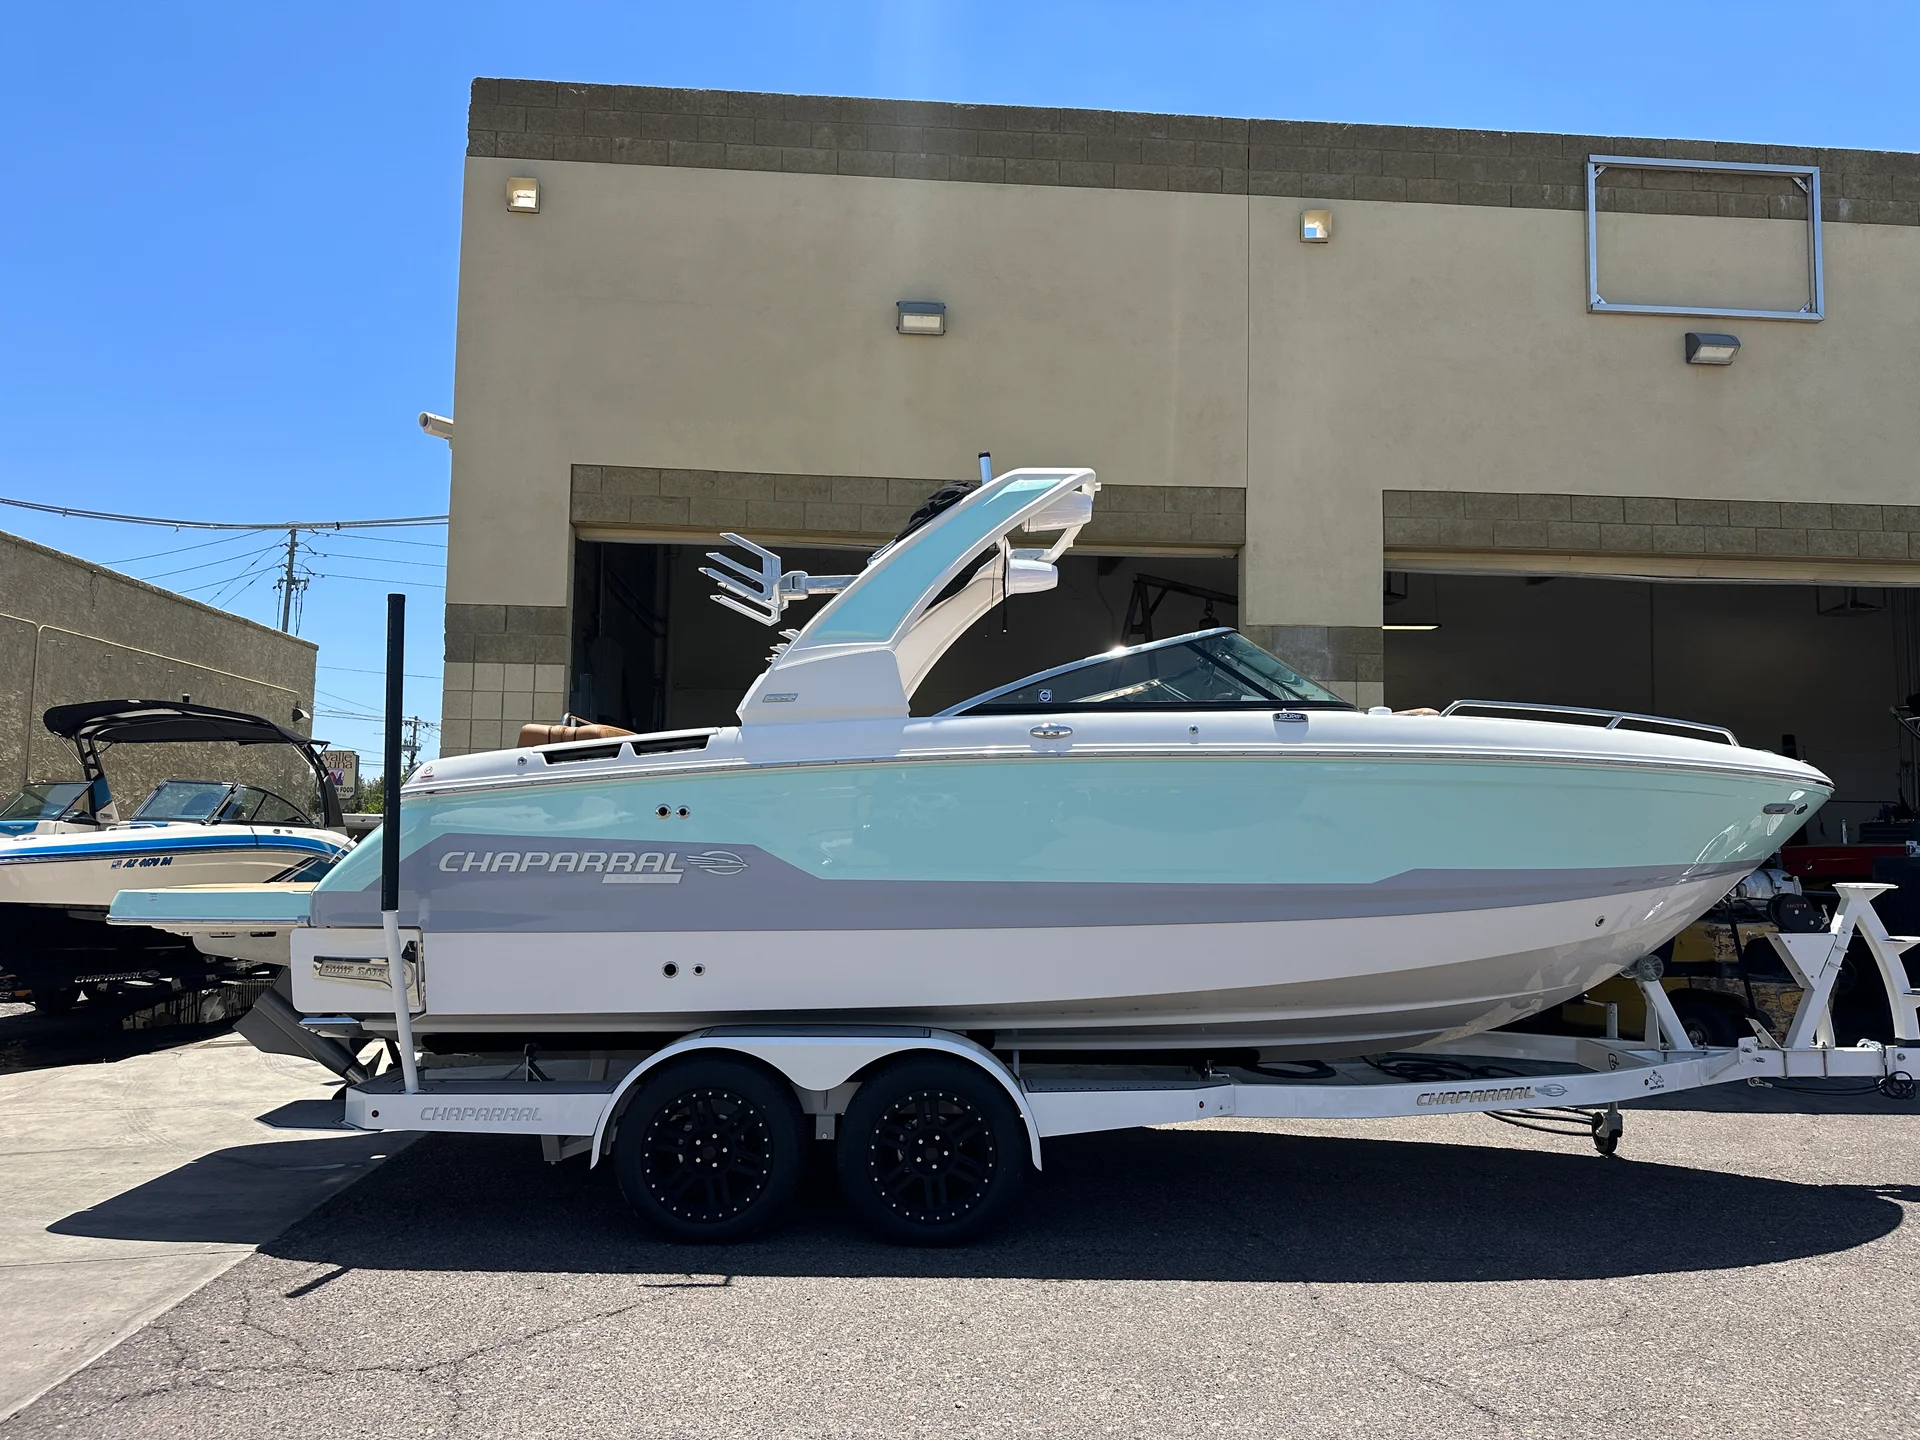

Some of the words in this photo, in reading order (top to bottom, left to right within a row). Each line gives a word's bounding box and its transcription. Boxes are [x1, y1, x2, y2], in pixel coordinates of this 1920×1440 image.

[323, 752, 352, 762] Valle
[327, 760, 353, 769] una
[438, 851, 685, 873] CHAPARRAL
[74, 971, 142, 983] CHAPARRAL
[324, 963, 354, 974] SURF
[356, 966, 385, 977] GATE
[1416, 1086, 1536, 1106] CHAPARRAL
[420, 1107, 543, 1122] CHAPARRAL
